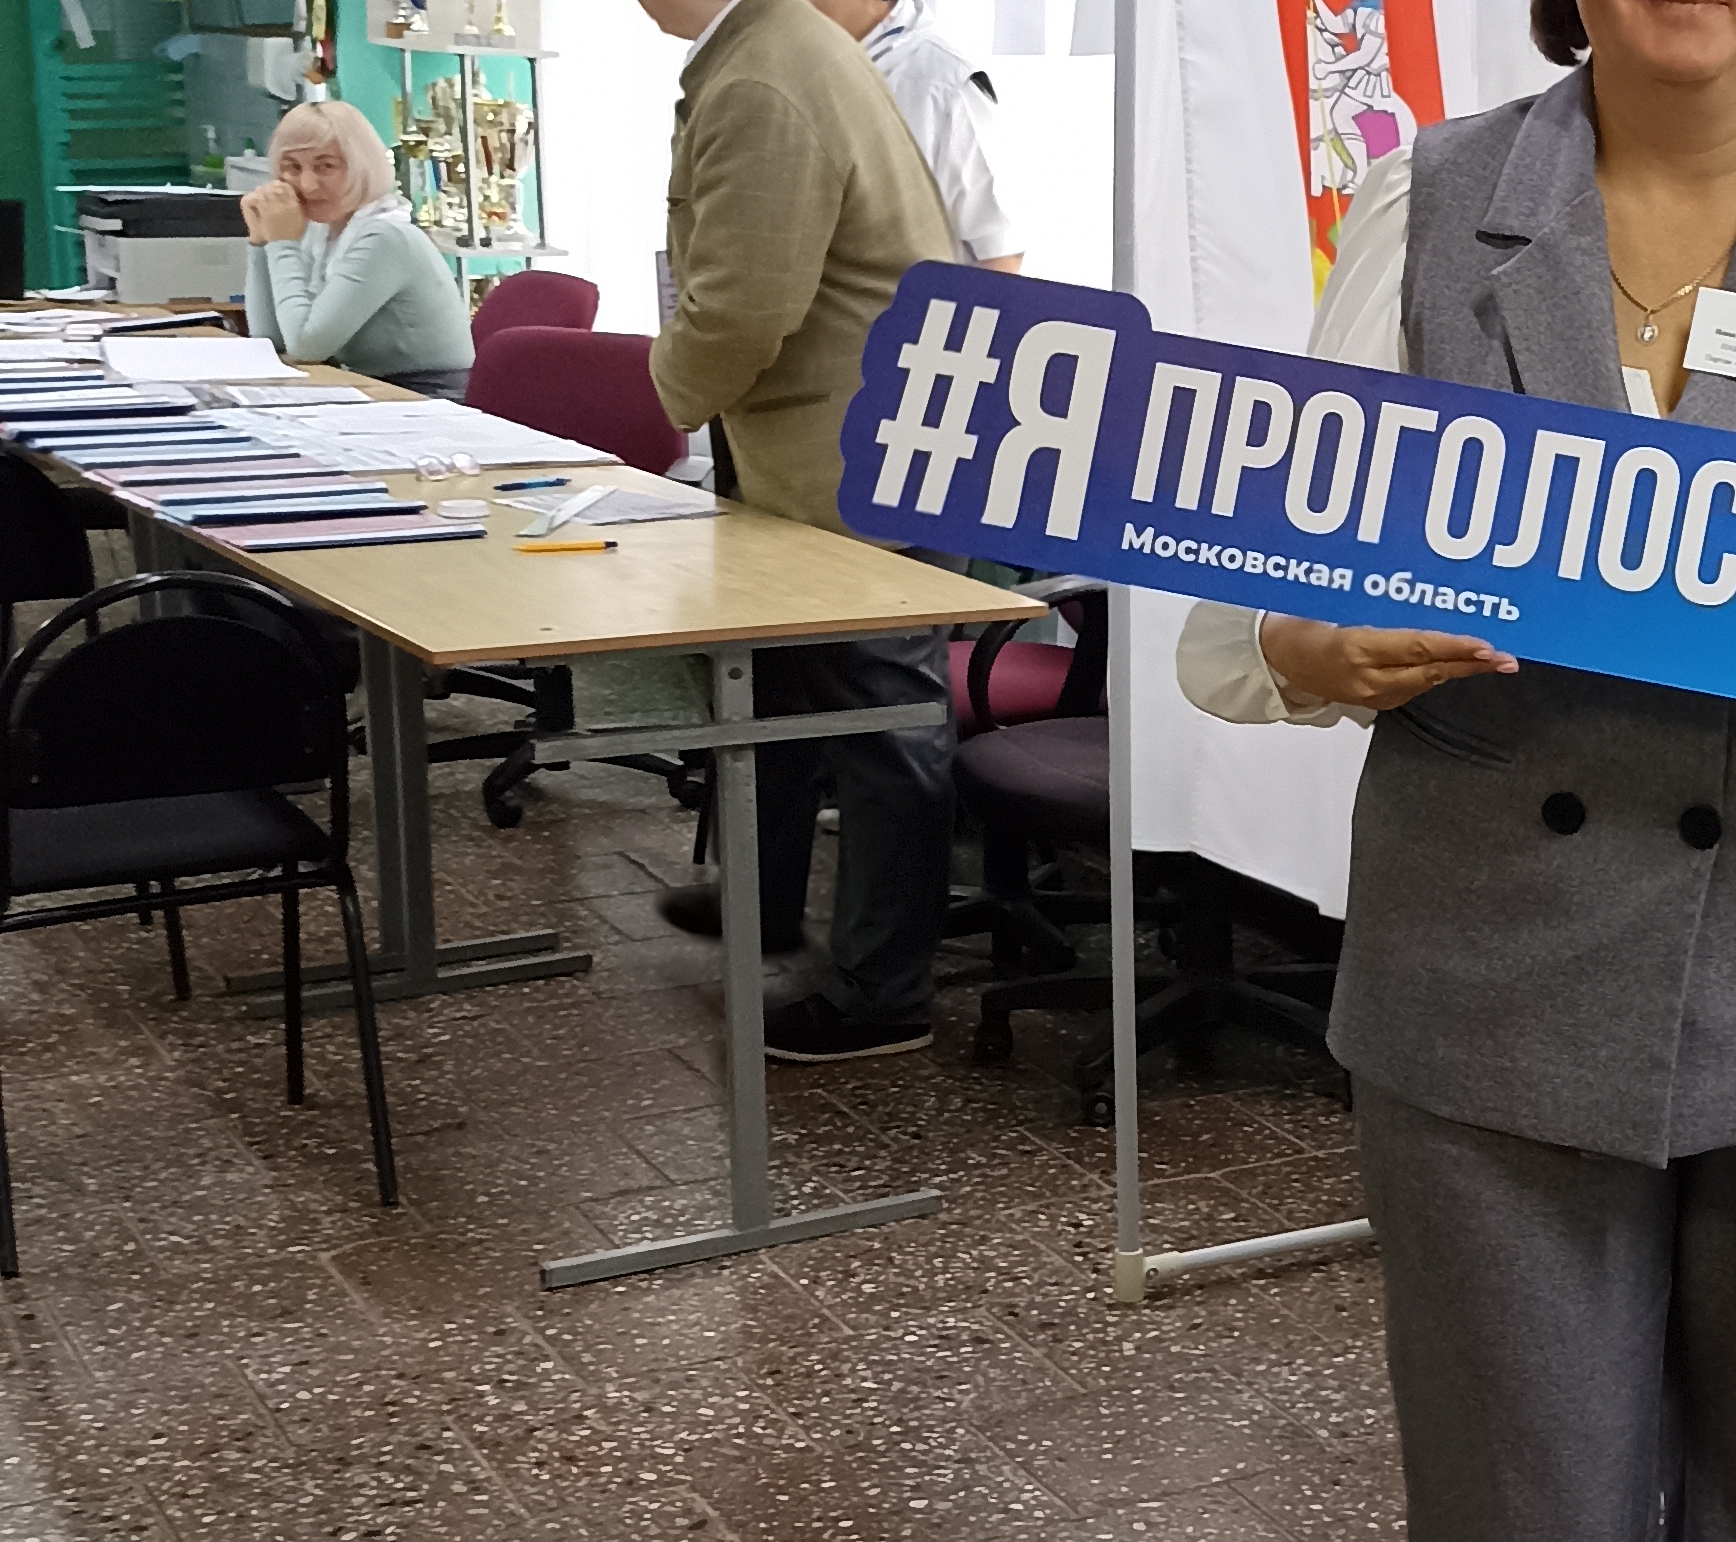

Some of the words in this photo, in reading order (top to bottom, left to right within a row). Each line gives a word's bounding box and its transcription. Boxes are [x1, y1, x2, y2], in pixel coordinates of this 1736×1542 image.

[871, 297, 1117, 541] #Я
[1121, 522, 1353, 591] Московская
[1363, 571, 1520, 622] область
